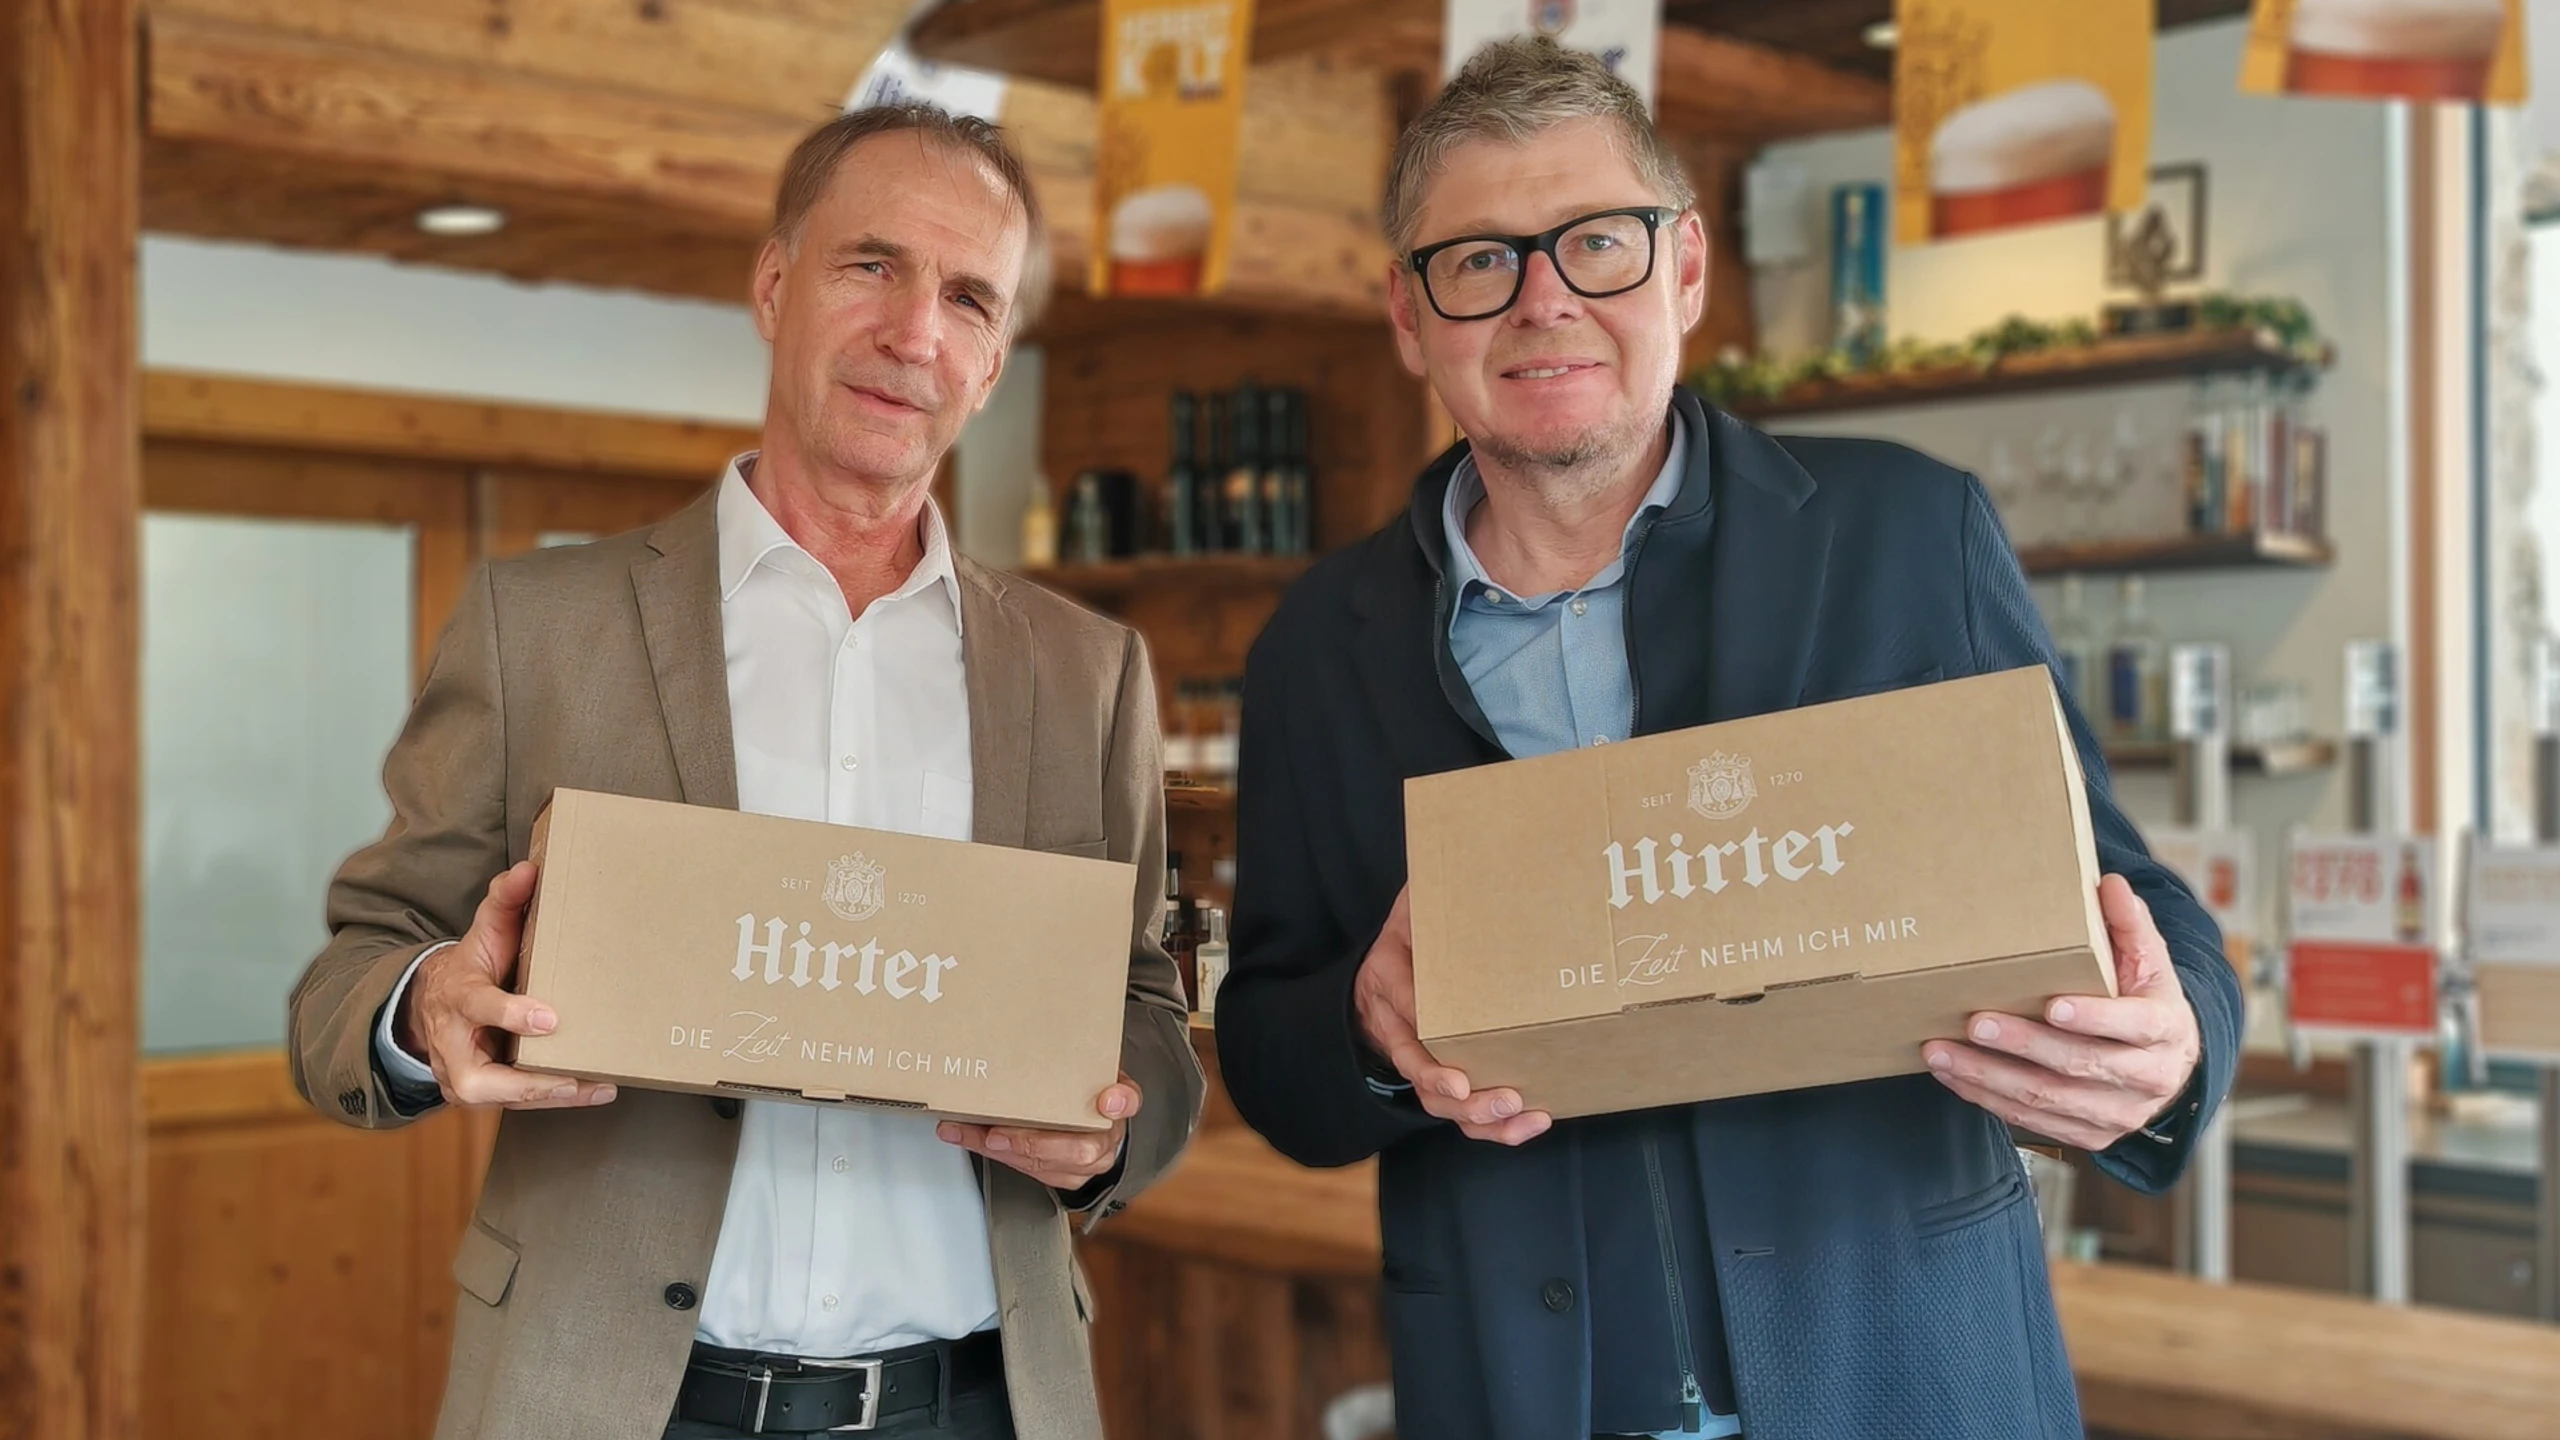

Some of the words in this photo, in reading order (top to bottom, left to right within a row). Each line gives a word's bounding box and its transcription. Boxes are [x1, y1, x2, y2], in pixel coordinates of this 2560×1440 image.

[1640, 793, 1674, 808] SEIT
[1769, 770, 1804, 787] 1270
[780, 875, 812, 892] SEIT
[897, 891, 928, 907] 1270
[1603, 821, 1855, 909] Hirter
[731, 912, 959, 1004] Hirter
[1559, 963, 1606, 989] DIE
[1617, 932, 1689, 987] Zeit
[1700, 936, 1784, 968] NEHM
[1798, 927, 1851, 954] ICH
[1864, 916, 1919, 945] MIR
[669, 1025, 714, 1050] DIE
[722, 1010, 792, 1063] Zeit
[800, 1039, 875, 1068] NEHM
[886, 1050, 932, 1073] ICH
[943, 1056, 989, 1080] MIR
